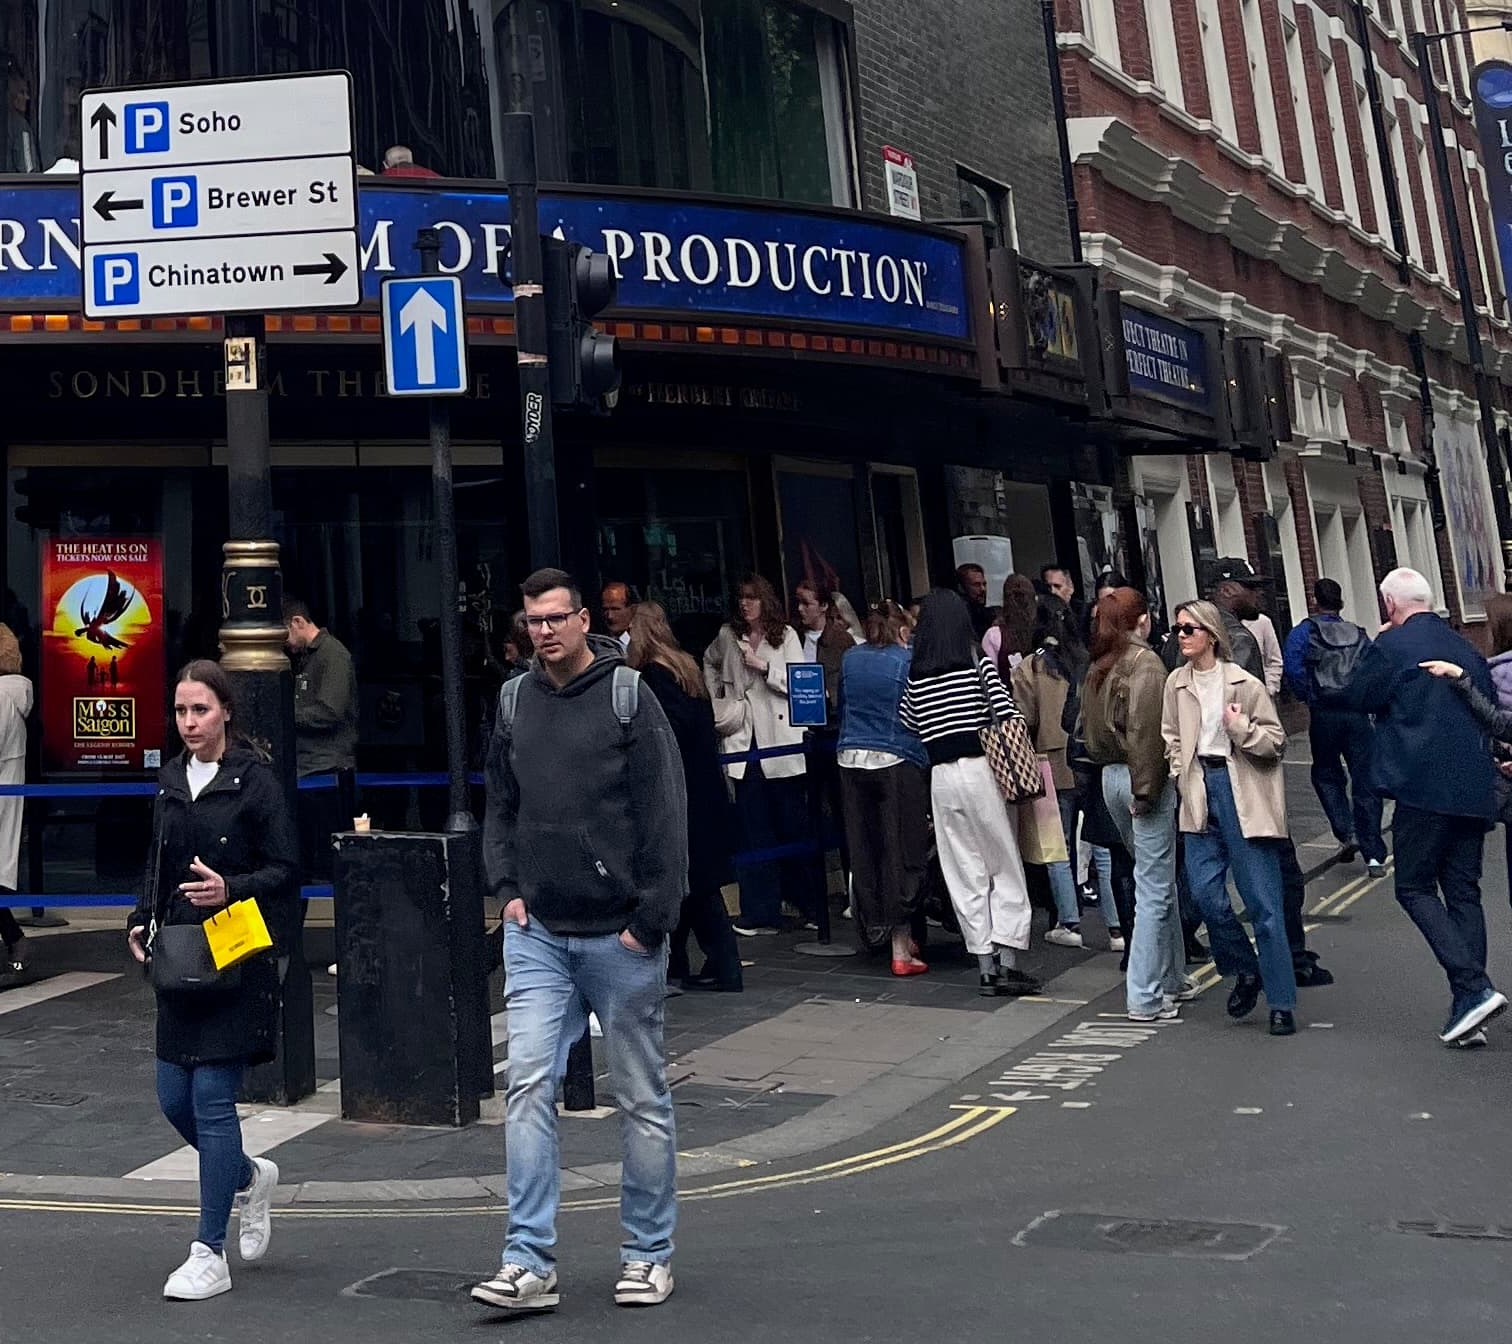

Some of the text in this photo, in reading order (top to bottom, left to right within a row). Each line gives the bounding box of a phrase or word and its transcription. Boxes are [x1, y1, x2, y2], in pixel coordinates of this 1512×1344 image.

[135, 107, 241, 149] P Soho
[163, 181, 339, 224] P Brewer St
[105, 259, 285, 301] P Chinatown
[48, 369, 287, 399] SONDHEM
[308, 369, 491, 400] THEE
[56, 543, 148, 554] THE HEAT IS ON
[56, 554, 148, 562] TICKETS NOW ON SALE
[77, 717, 130, 737] Saigon
